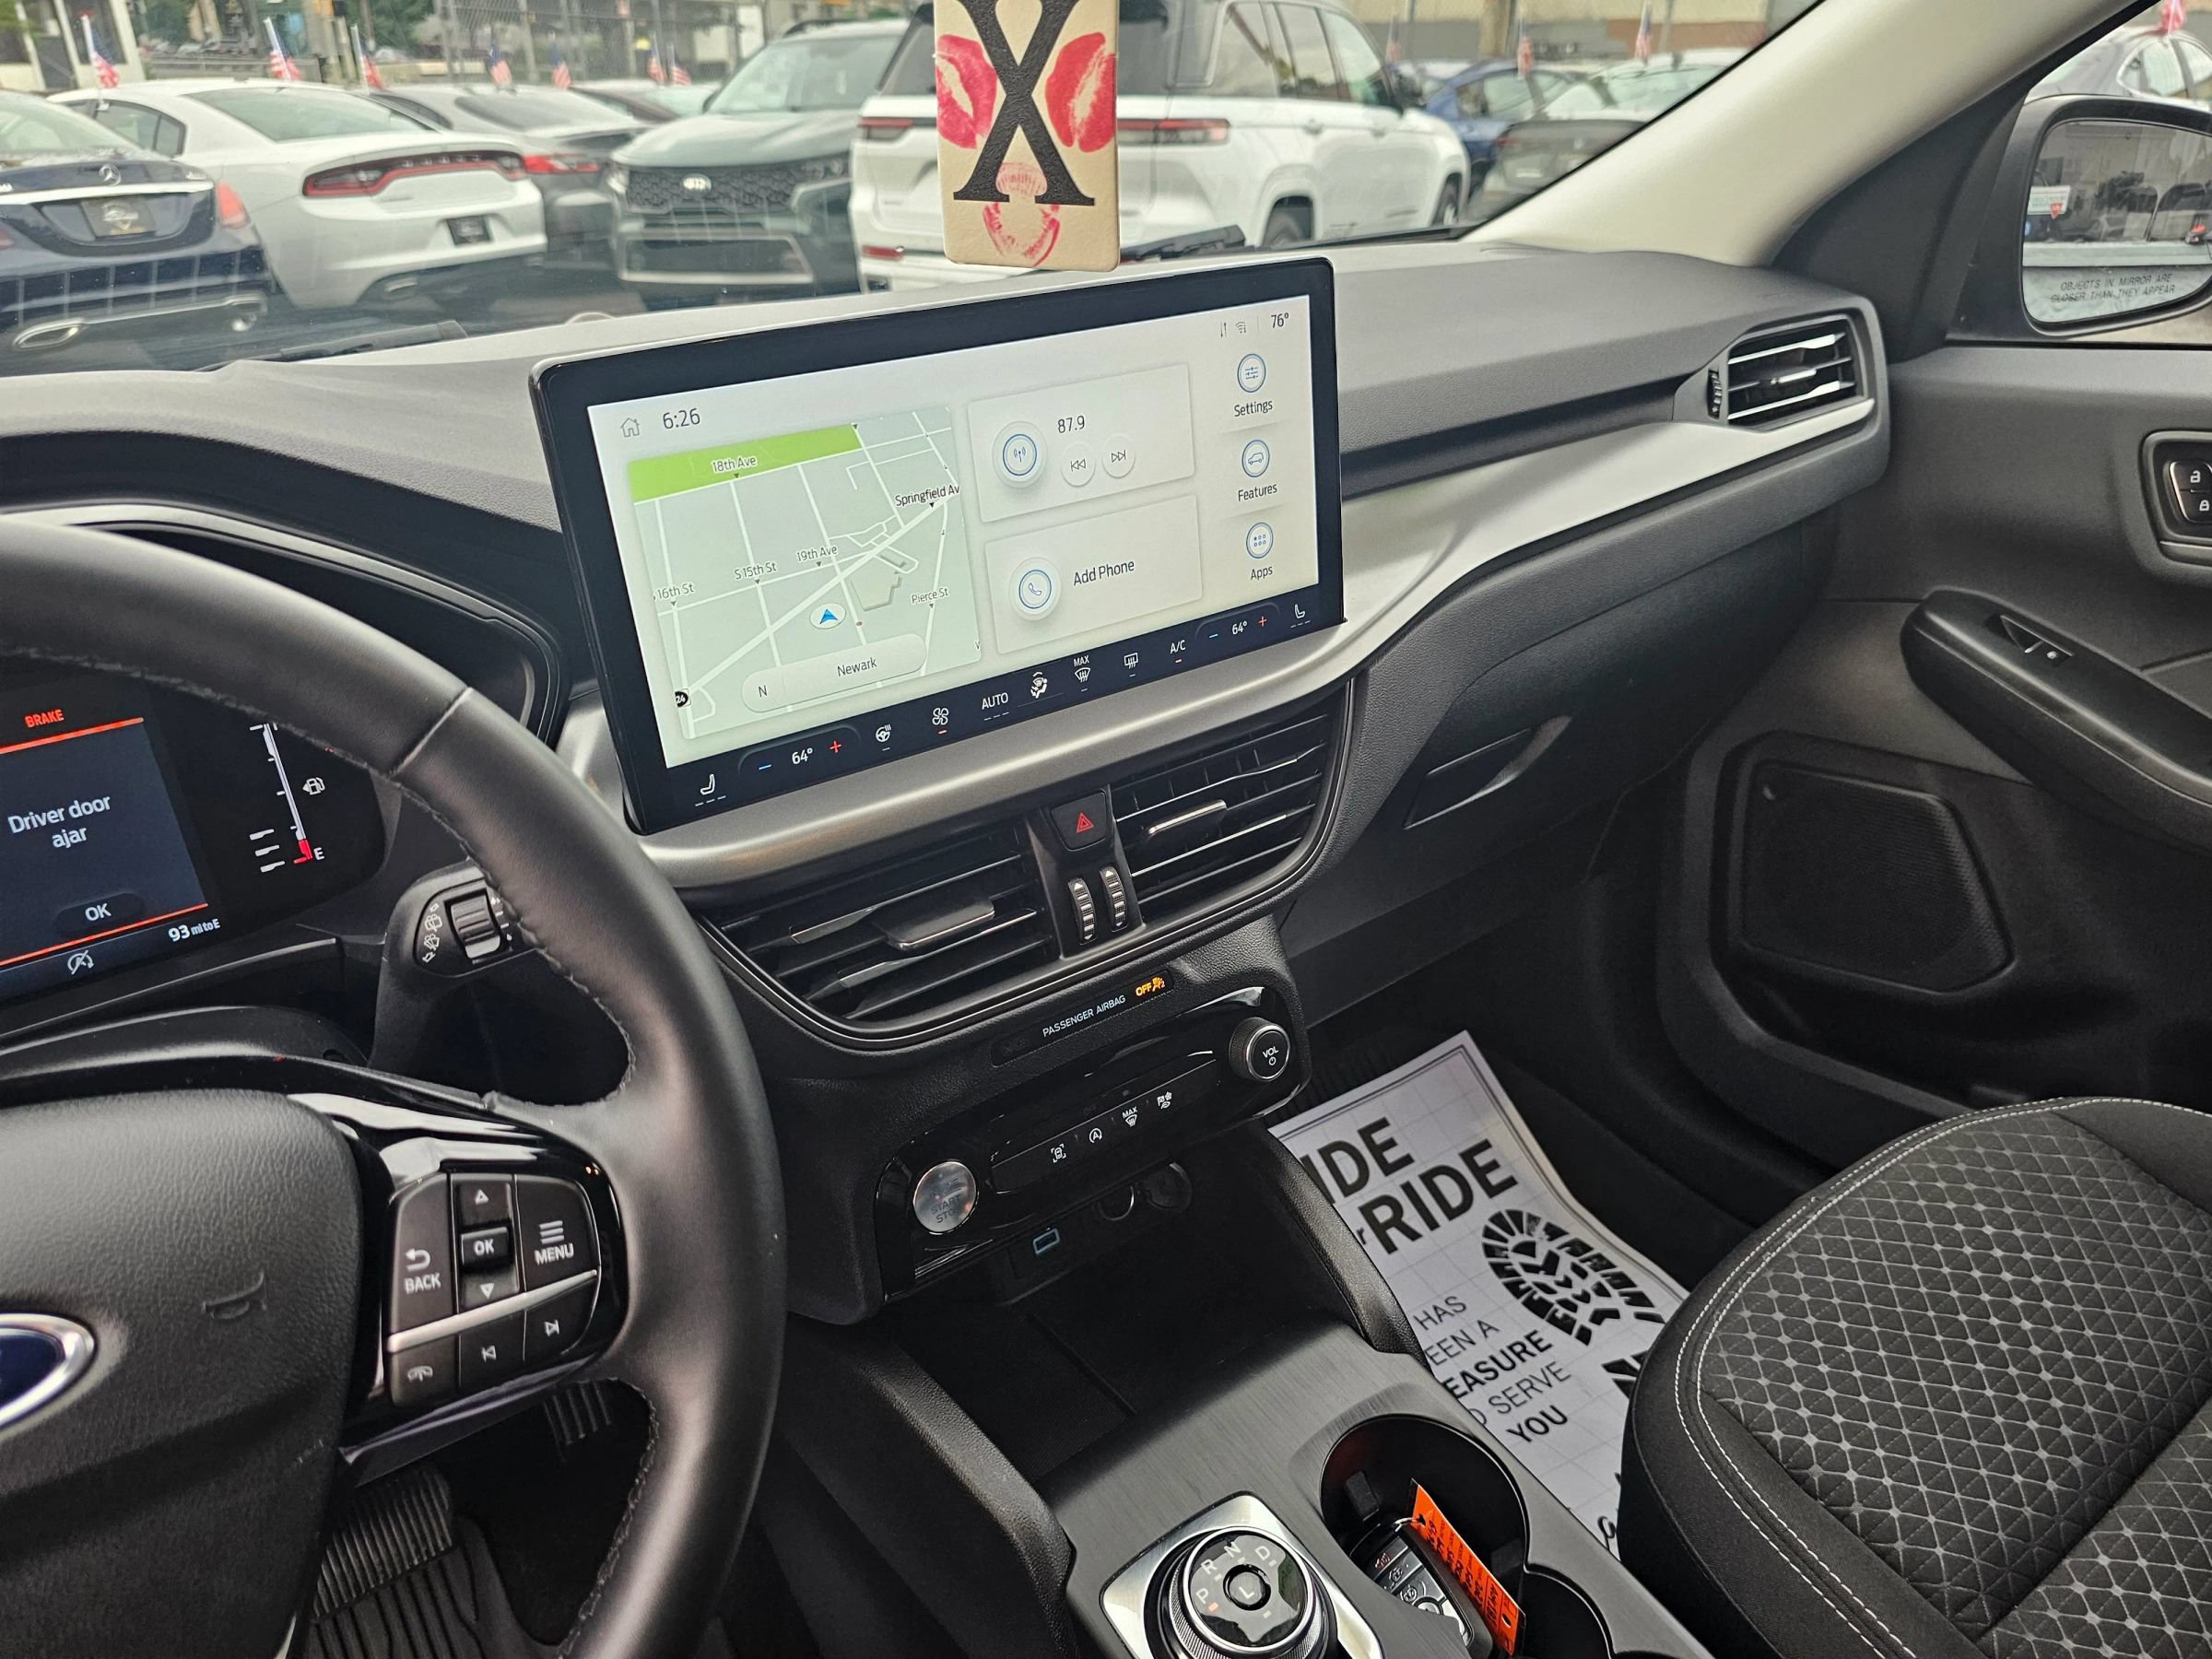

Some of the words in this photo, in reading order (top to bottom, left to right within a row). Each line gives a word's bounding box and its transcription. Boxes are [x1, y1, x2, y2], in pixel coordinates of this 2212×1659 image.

[953, 0, 1095, 206] X
[2060, 278, 2100, 291] OBJECTS
[2104, 277, 2114, 288] IN
[2119, 276, 2151, 287] MIRROR
[2155, 273, 2172, 283] ARE
[2090, 290, 2113, 300] THAN
[2119, 288, 2138, 298] THEY
[2143, 285, 2175, 296] APPEAR
[1233, 399, 1273, 418] Settings
[663, 407, 701, 430] 6:26
[1057, 415, 1086, 434] 87.9
[712, 457, 735, 473] 18th
[737, 454, 757, 468] Ave
[895, 486, 946, 507] Springfield
[1238, 482, 1277, 502] Features
[796, 547, 817, 562] 19th
[817, 544, 838, 558] Ave
[735, 568, 742, 581] S
[742, 563, 763, 579] 15th
[764, 561, 778, 574] St
[1073, 571, 1097, 586] Add
[1099, 559, 1135, 580] Phone
[1250, 564, 1273, 581] Apps
[657, 586, 680, 600] 16th
[682, 582, 694, 594] St
[911, 589, 935, 605] Pierce
[935, 585, 948, 599] St
[1170, 639, 1186, 654] A/C
[837, 657, 877, 677] Newark
[1074, 654, 1089, 667] MAX
[758, 685, 768, 698] N
[982, 692, 1009, 710] AUTO
[24, 709, 65, 728] BRAKE
[7, 804, 65, 834] Driver
[69, 794, 112, 819] door
[52, 823, 88, 850] ajar
[313, 846, 325, 861] E
[85, 901, 112, 922] OK
[168, 924, 190, 942] 93
[1135, 982, 1151, 996] OFF
[1042, 1008, 1094, 1037] PASSENGER
[1096, 994, 1126, 1015] AIRBAG
[1262, 1046, 1279, 1059] VOL
[1122, 1106, 1137, 1118] MAX
[931, 1194, 960, 1215] START
[1358, 1138, 1518, 1254] RIDE
[473, 1238, 495, 1256] OK
[534, 1242, 574, 1265] MENU
[404, 1273, 441, 1295] BACK
[1413, 1295, 1466, 1331] HAS
[1424, 1329, 1477, 1366] EEN
[1477, 1319, 1500, 1339] A
[1442, 1329, 1553, 1399] EASURE
[1488, 1360, 1571, 1415] SERVE
[1506, 1405, 1568, 1443] YOU
[1224, 1541, 1241, 1559] N
[1254, 1545, 1271, 1561] D
[1200, 1559, 1218, 1575] R
[1195, 1587, 1208, 1605] P
[1239, 1586, 1254, 1599] L
